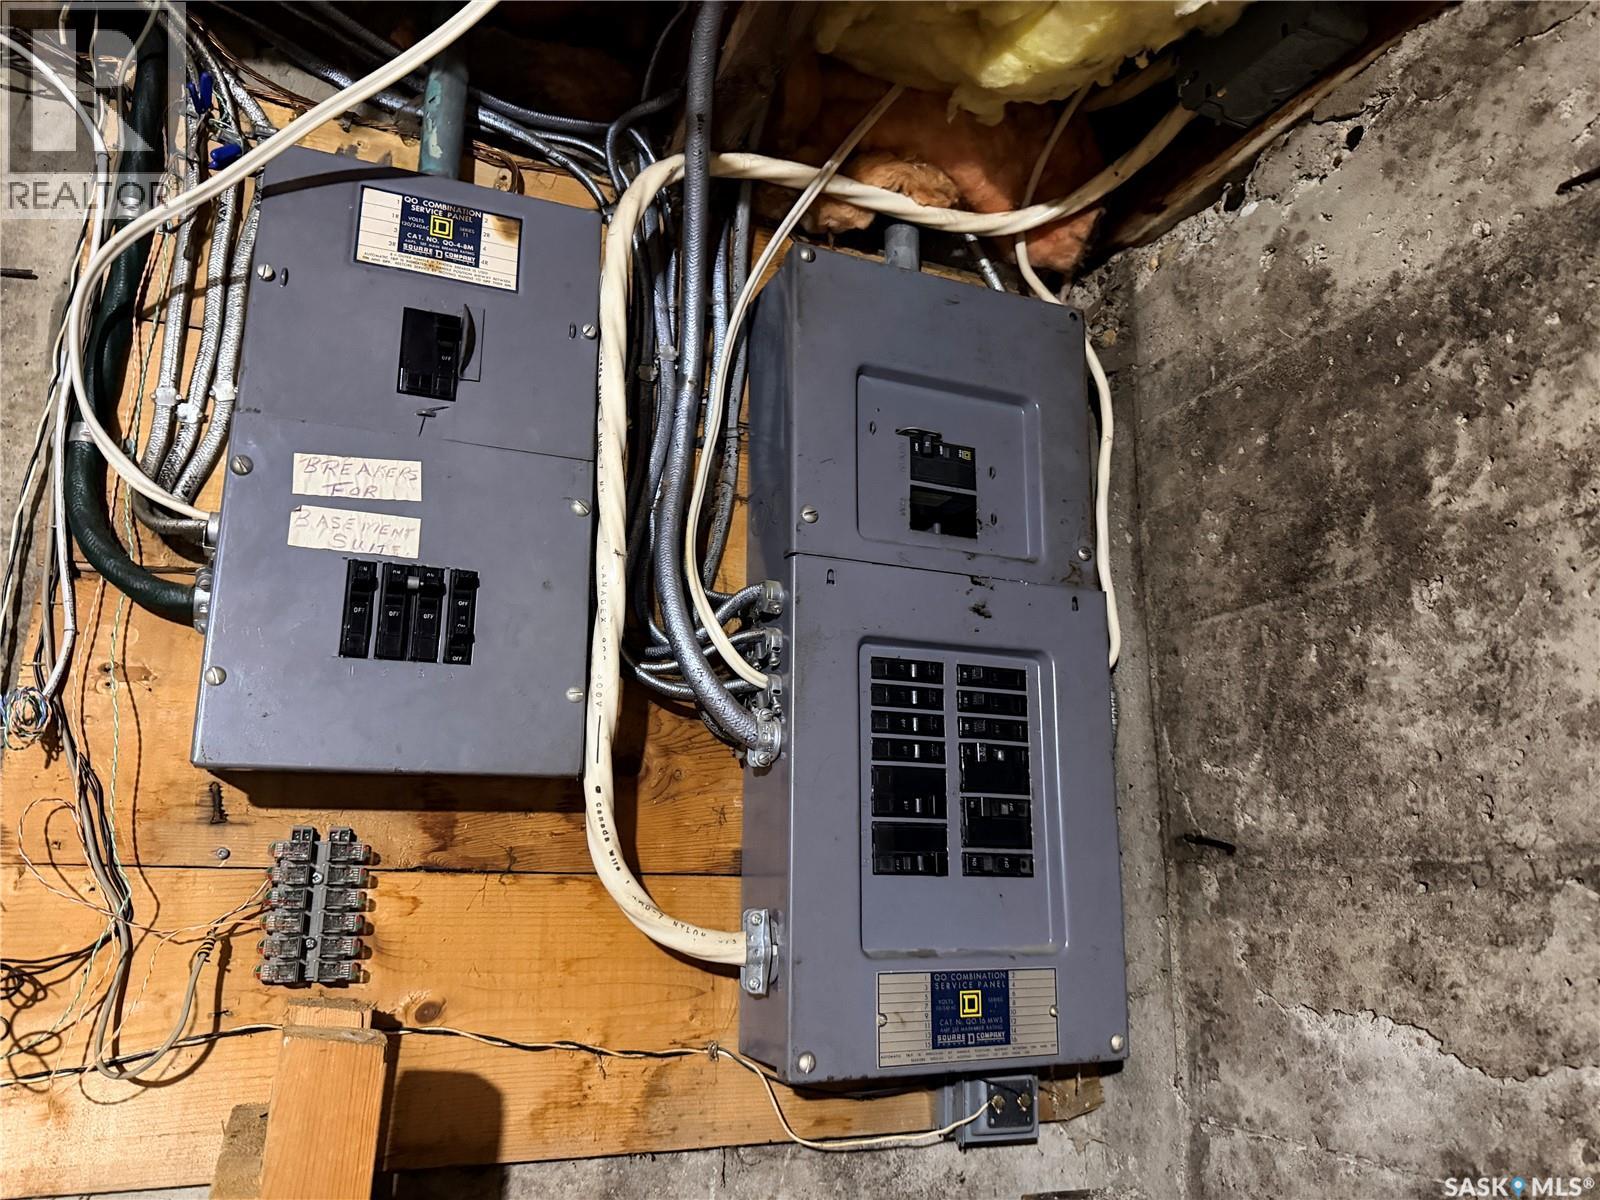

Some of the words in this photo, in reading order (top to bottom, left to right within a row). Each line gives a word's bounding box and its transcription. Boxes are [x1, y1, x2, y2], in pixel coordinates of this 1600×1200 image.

[404, 196, 418, 204] QO
[422, 200, 482, 218] COMBINATION
[411, 204, 444, 216] SERVICE
[448, 212, 472, 223] PANEL
[435, 250, 443, 259] D
[444, 252, 475, 262] COMPANY
[300, 456, 418, 481] BREAKERS
[322, 482, 378, 498] FOR
[294, 510, 416, 540] BASEMENT
[950, 972, 1006, 981] COMBINATION
[937, 1034, 965, 1042] SQUARE
